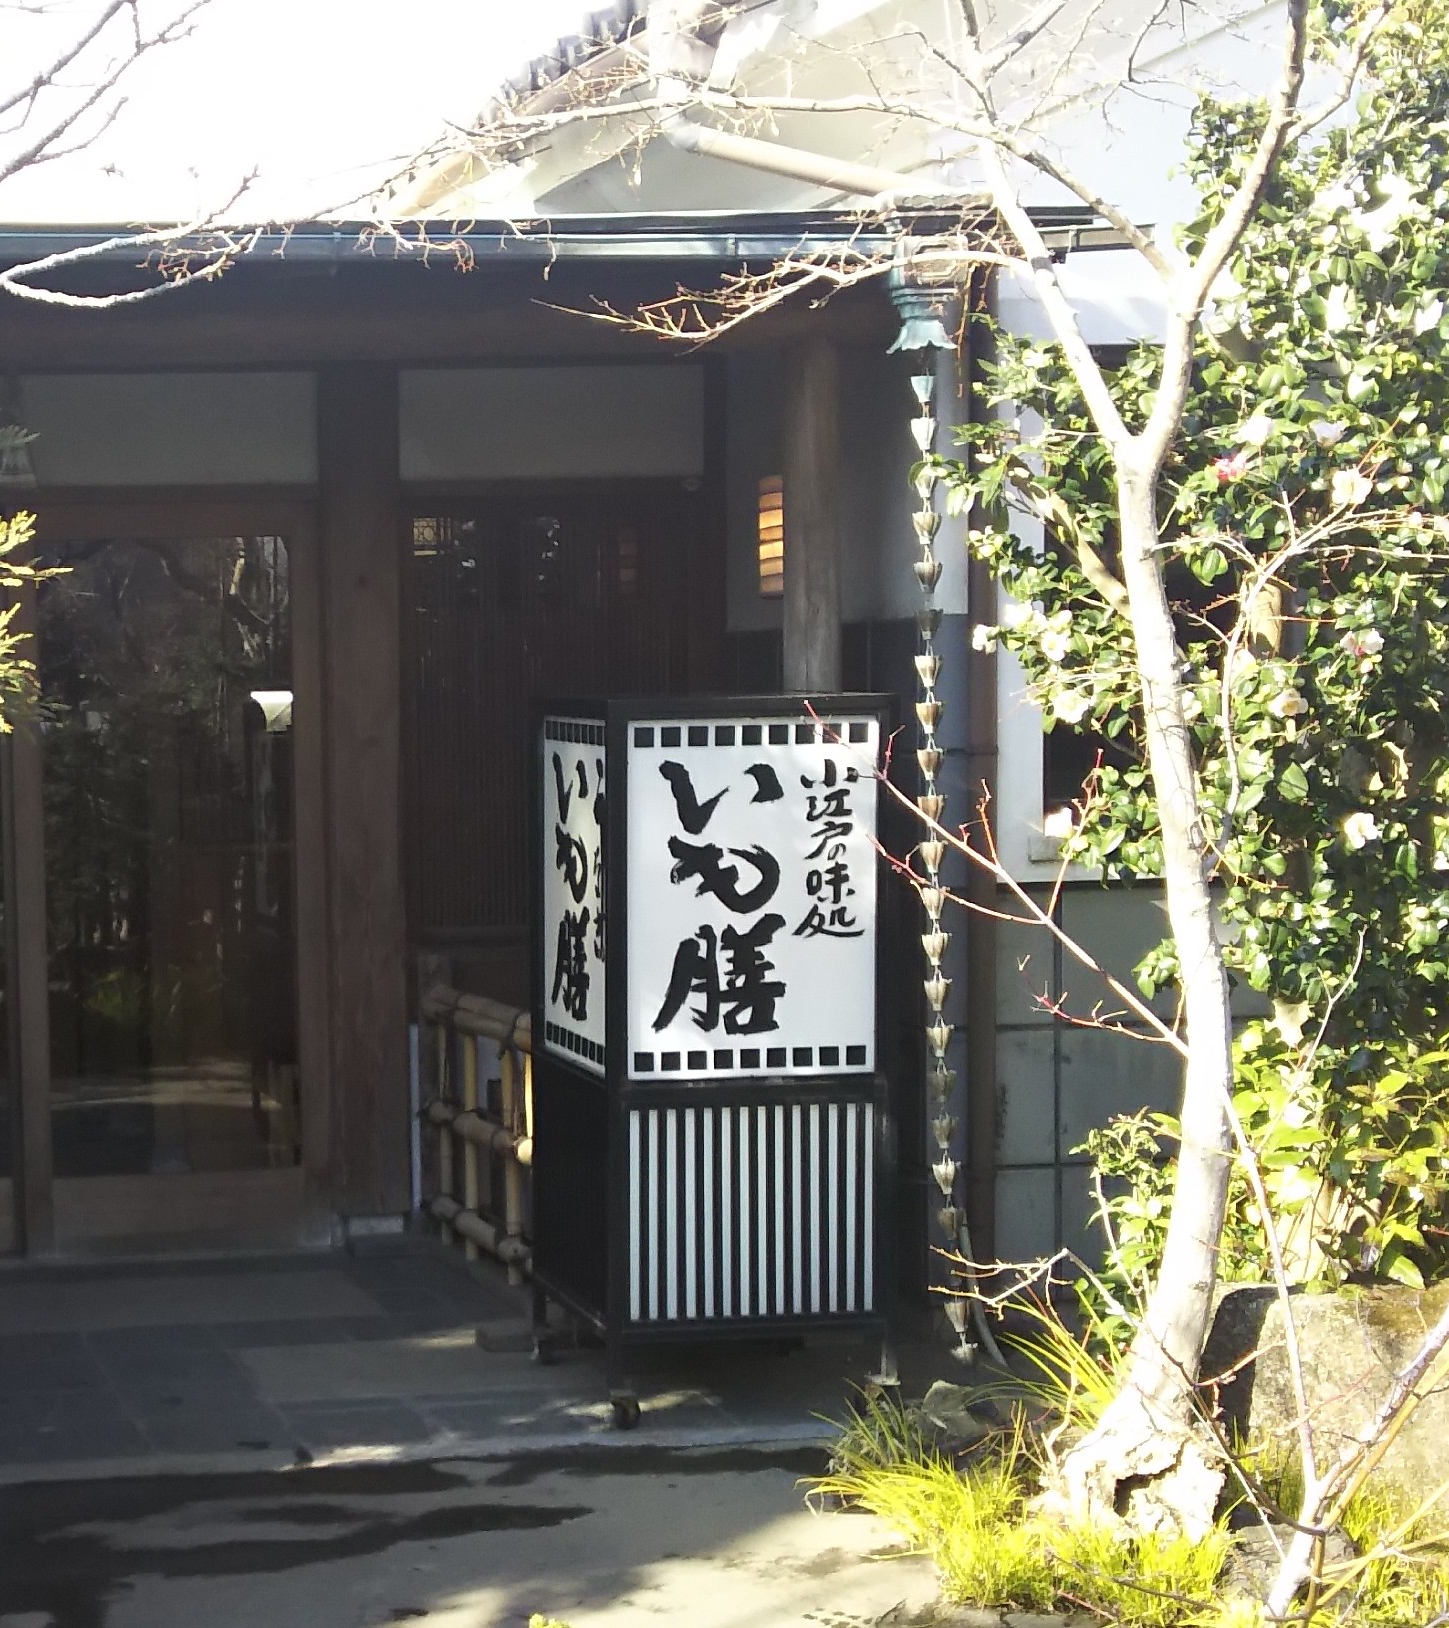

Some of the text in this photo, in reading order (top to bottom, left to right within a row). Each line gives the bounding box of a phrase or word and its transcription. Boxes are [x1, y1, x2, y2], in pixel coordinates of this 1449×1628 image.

[791, 758, 866, 939] 小江戸の味処
